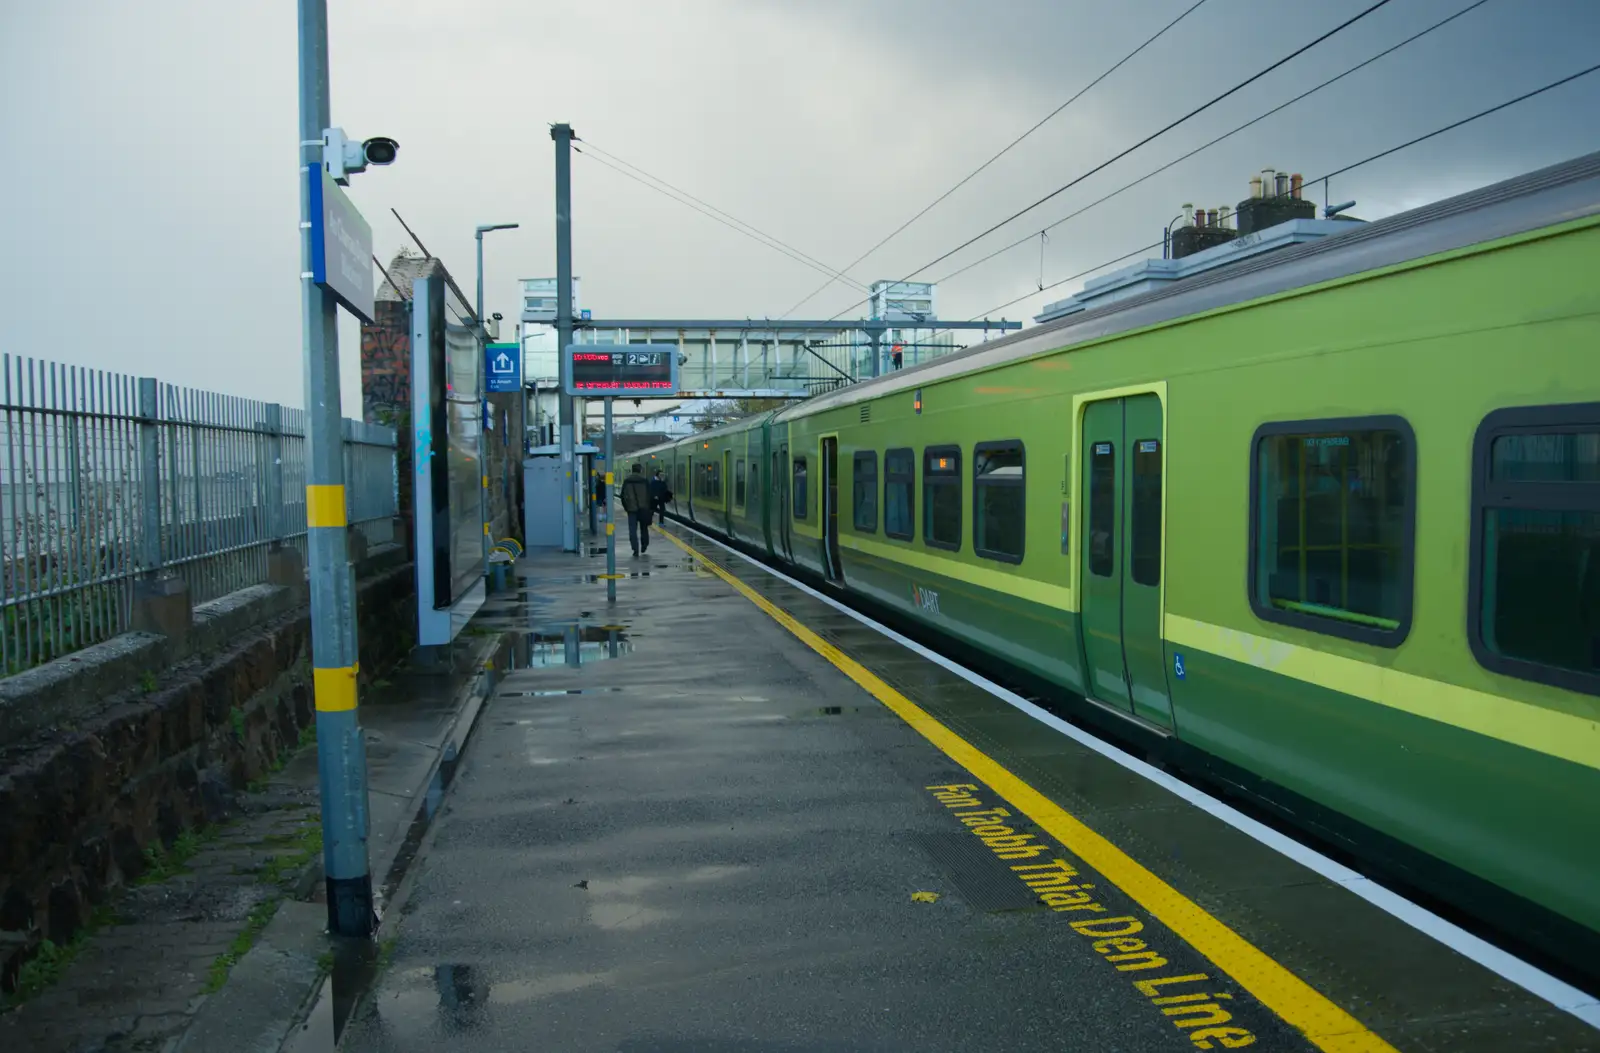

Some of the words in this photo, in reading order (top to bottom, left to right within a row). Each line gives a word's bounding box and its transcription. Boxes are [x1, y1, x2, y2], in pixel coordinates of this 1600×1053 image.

[628, 354, 637, 364] 2
[925, 783, 983, 808] Fan
[954, 806, 1050, 860] Taobh
[1009, 858, 1108, 912] Thiar
[1068, 915, 1169, 972] Den
[1131, 972, 1257, 1050] Line
